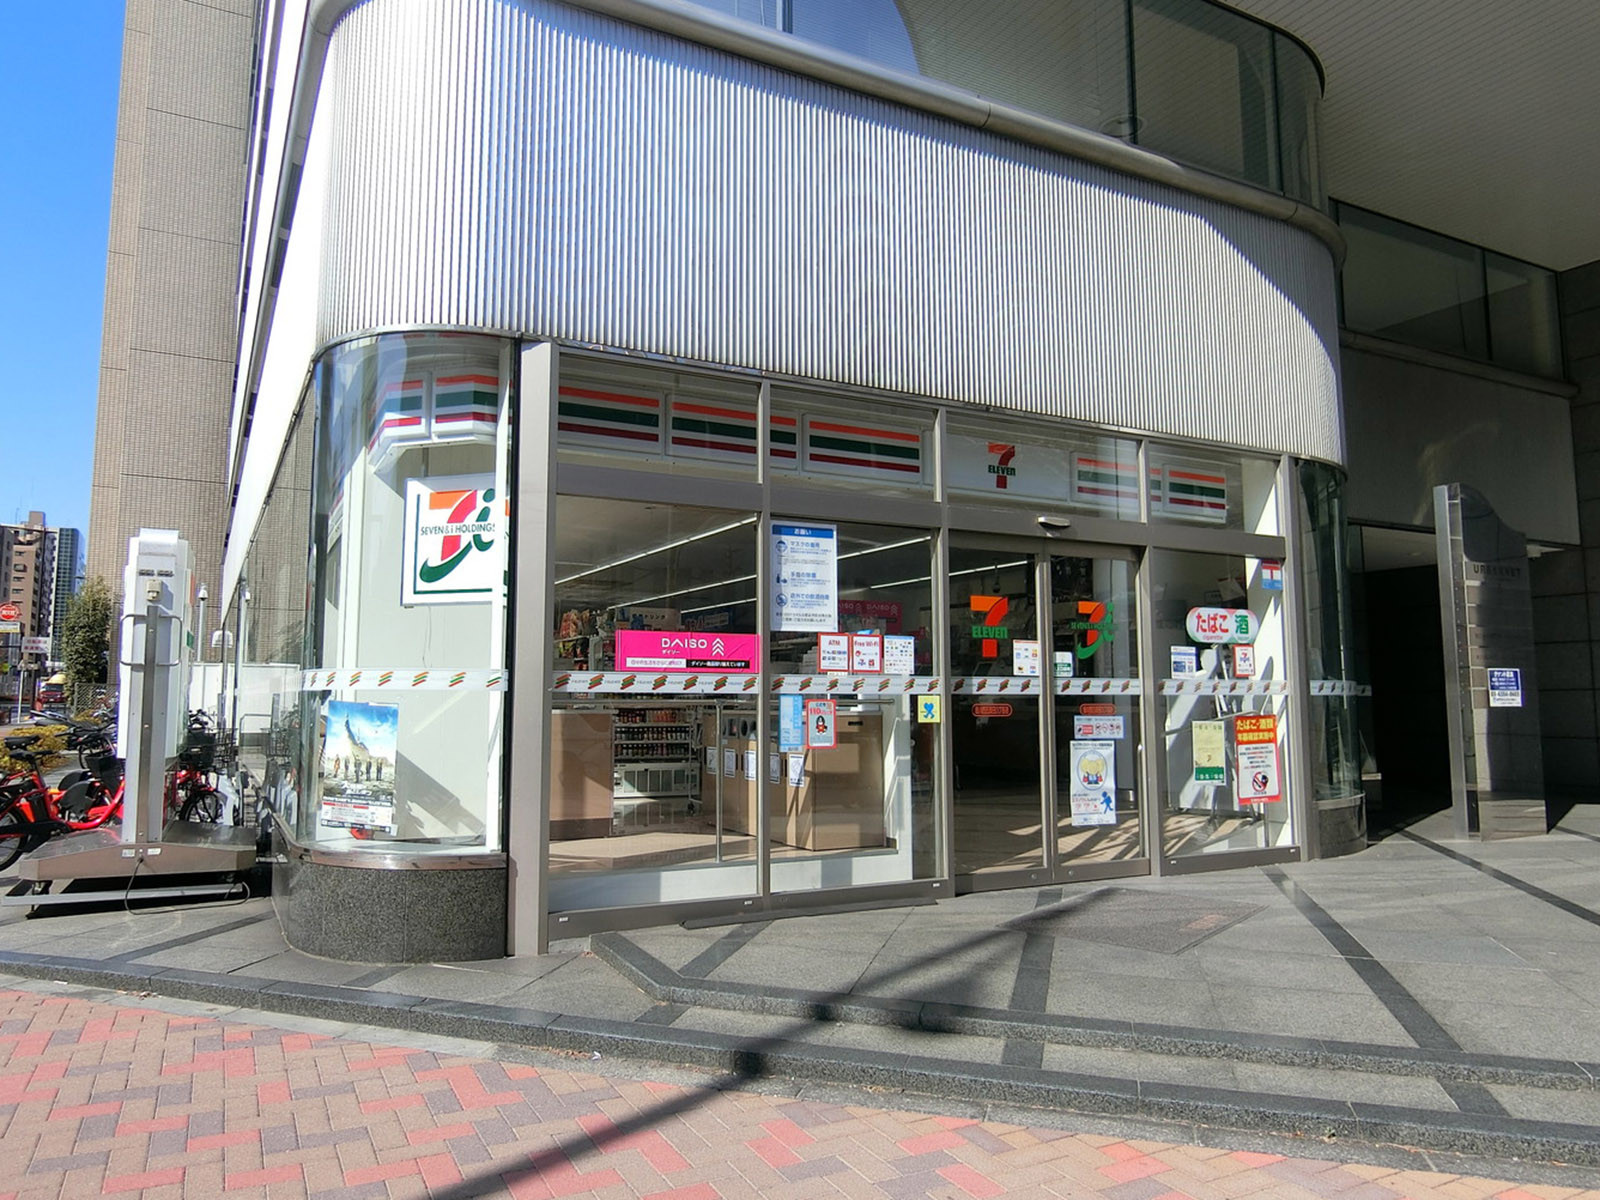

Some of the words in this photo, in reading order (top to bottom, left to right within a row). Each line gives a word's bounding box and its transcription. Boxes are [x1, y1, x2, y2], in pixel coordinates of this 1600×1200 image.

[1195, 612, 1229, 634] たばこ
[1235, 615, 1249, 634] 酒
[661, 637, 708, 649] DAISO
